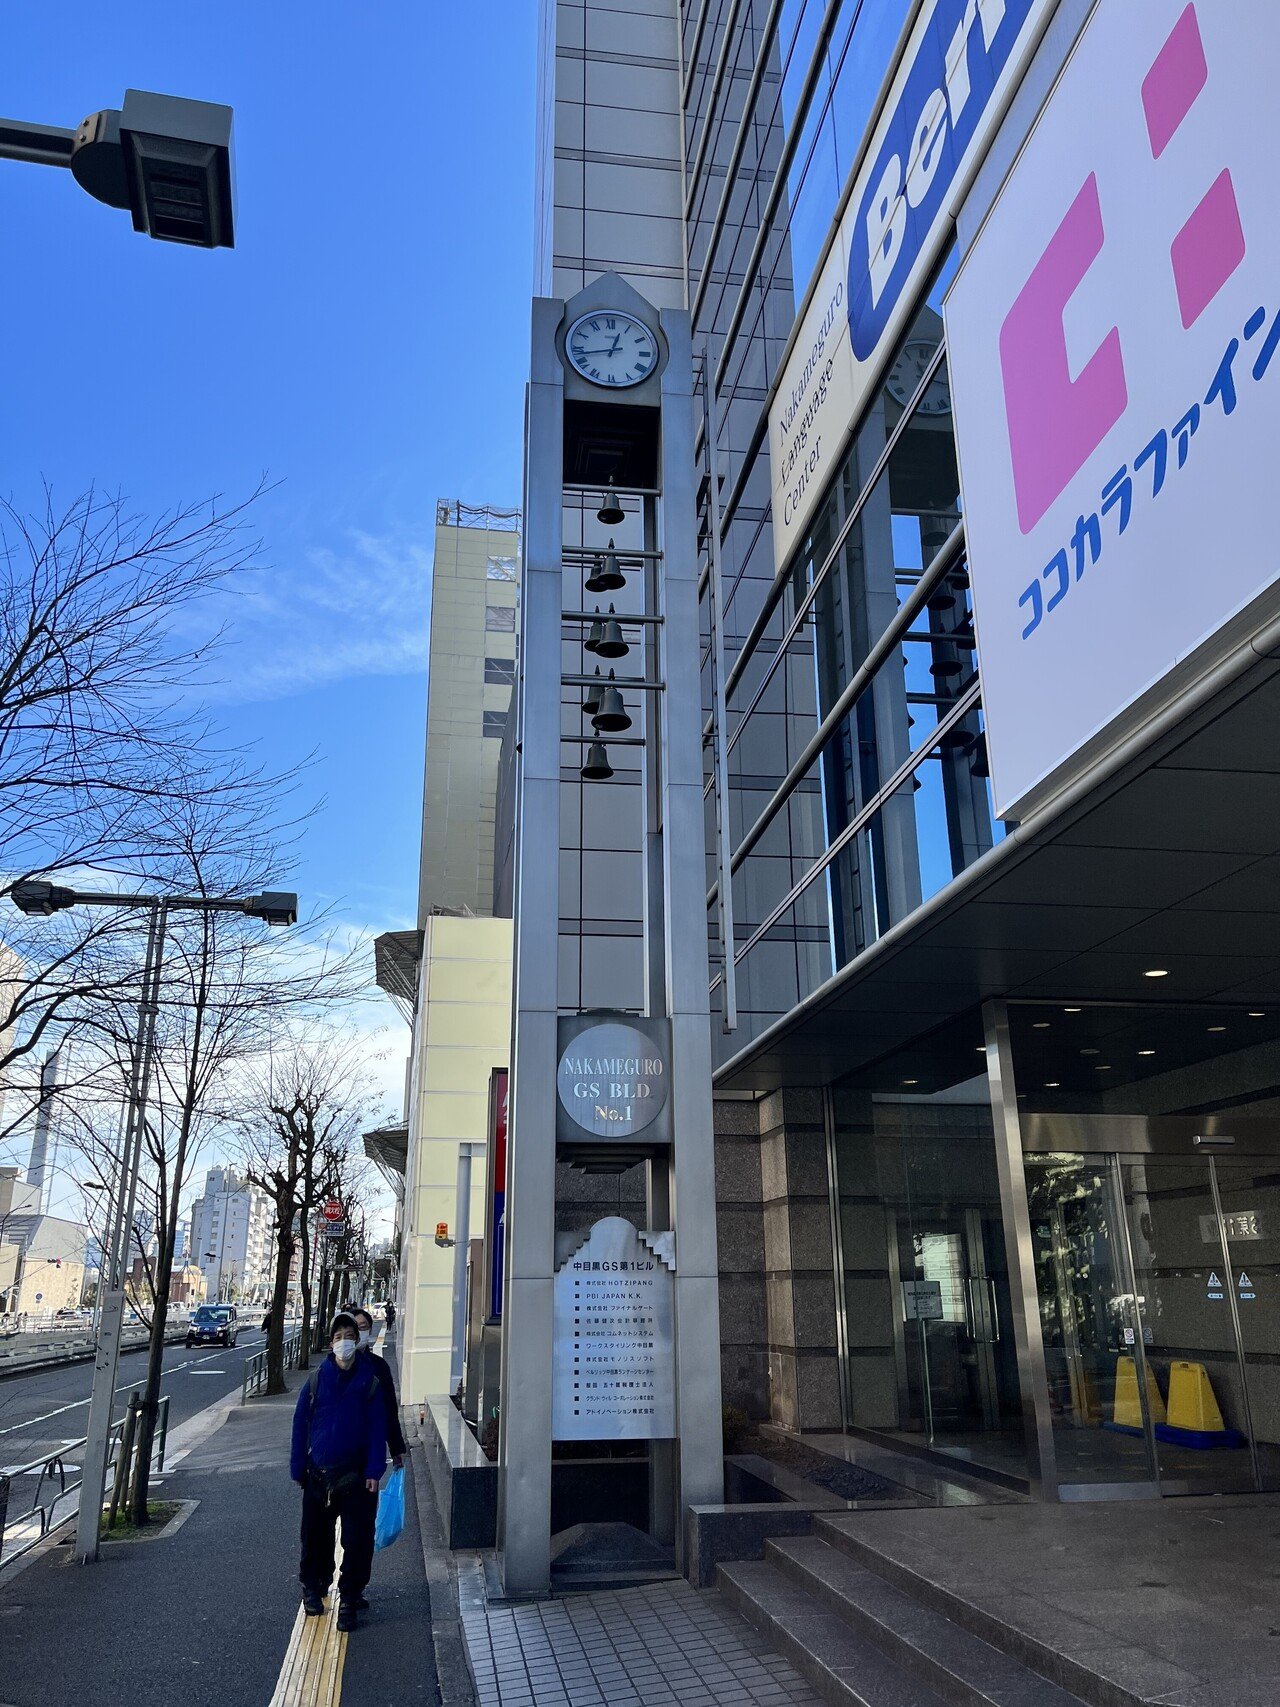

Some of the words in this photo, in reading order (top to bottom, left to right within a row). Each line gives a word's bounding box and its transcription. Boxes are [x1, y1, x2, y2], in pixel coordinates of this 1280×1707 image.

[779, 281, 843, 447] Nakameguro
[780, 357, 834, 488] Language
[783, 434, 822, 527] Center
[1018, 305, 1280, 641] ココカラファイン
[564, 1057, 664, 1076] NAKAMEGURO
[573, 1082, 600, 1098] GS
[609, 1083, 651, 1098] BLD
[594, 1105, 633, 1121] No.1
[573, 1261, 654, 1271] 中目黒GS第1ビル
